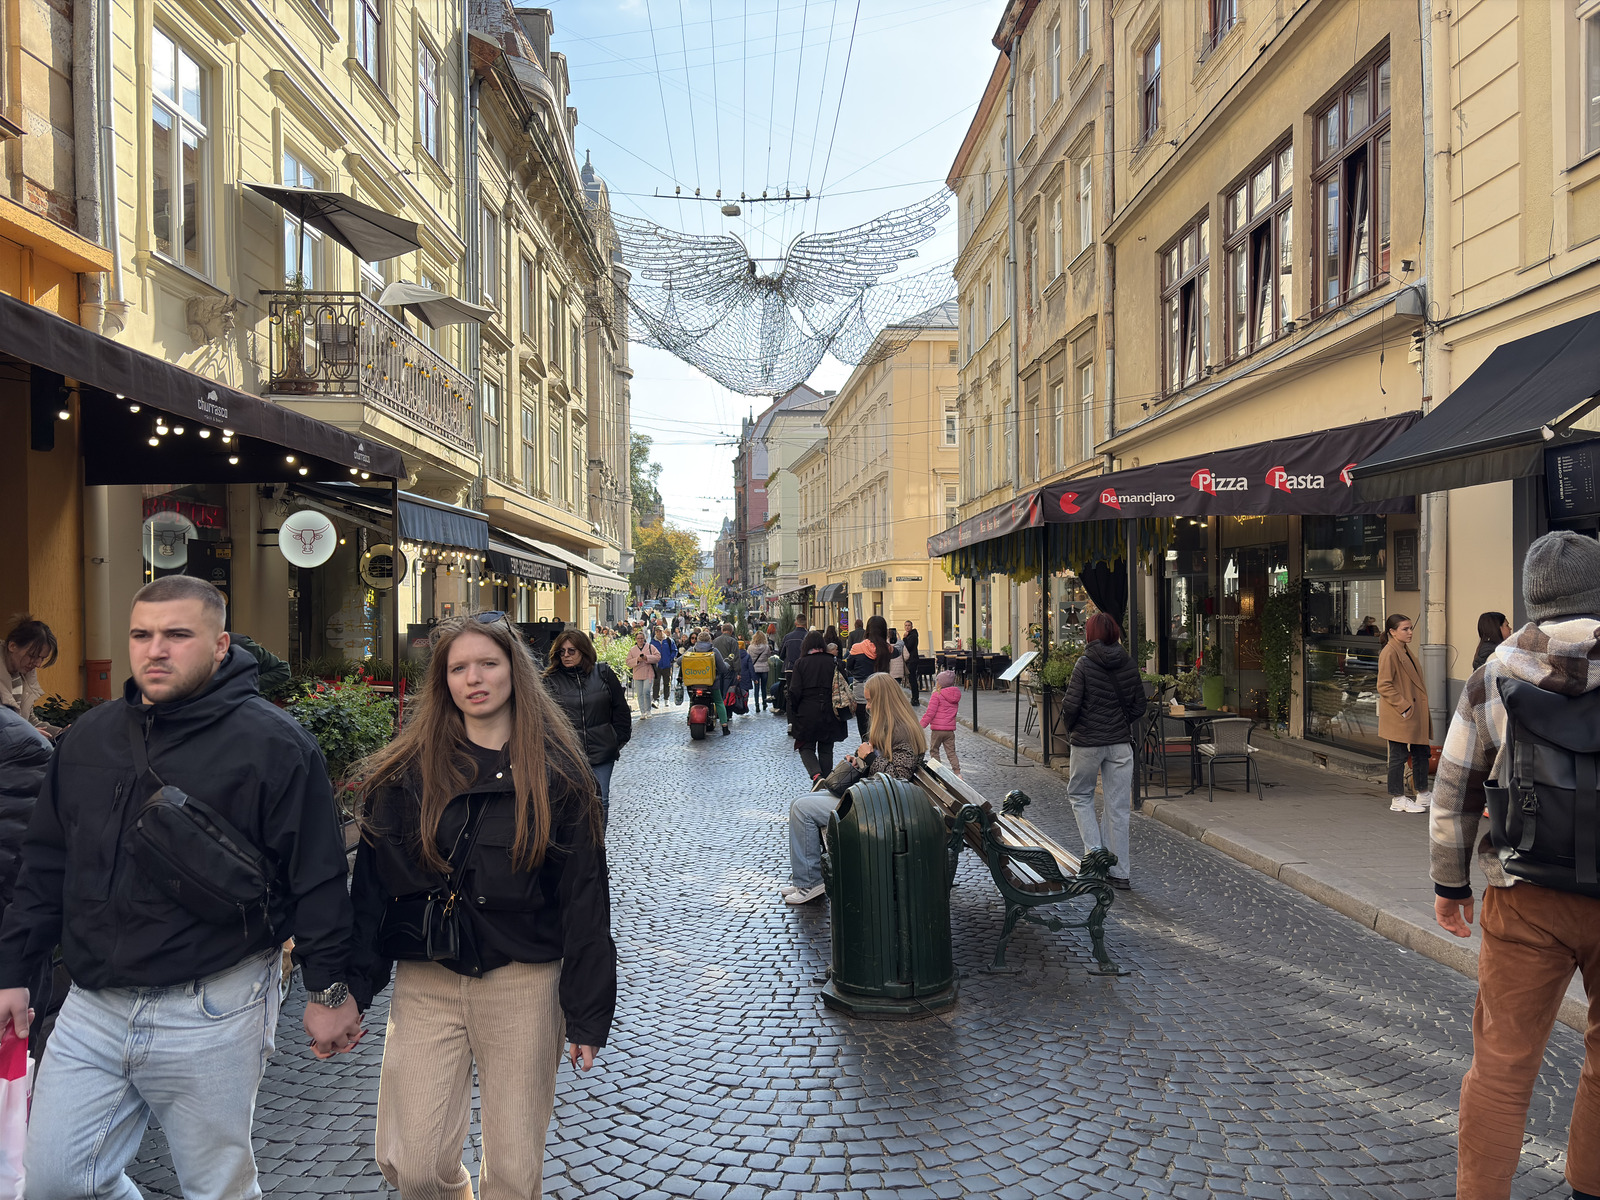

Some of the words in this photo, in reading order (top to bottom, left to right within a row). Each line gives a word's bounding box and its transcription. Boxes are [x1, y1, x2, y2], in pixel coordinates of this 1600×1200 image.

[197, 396, 228, 418] churrasco
[1198, 472, 1249, 492] Pizza
[1274, 471, 1325, 490] Pasta
[684, 668, 708, 676] Glovo
